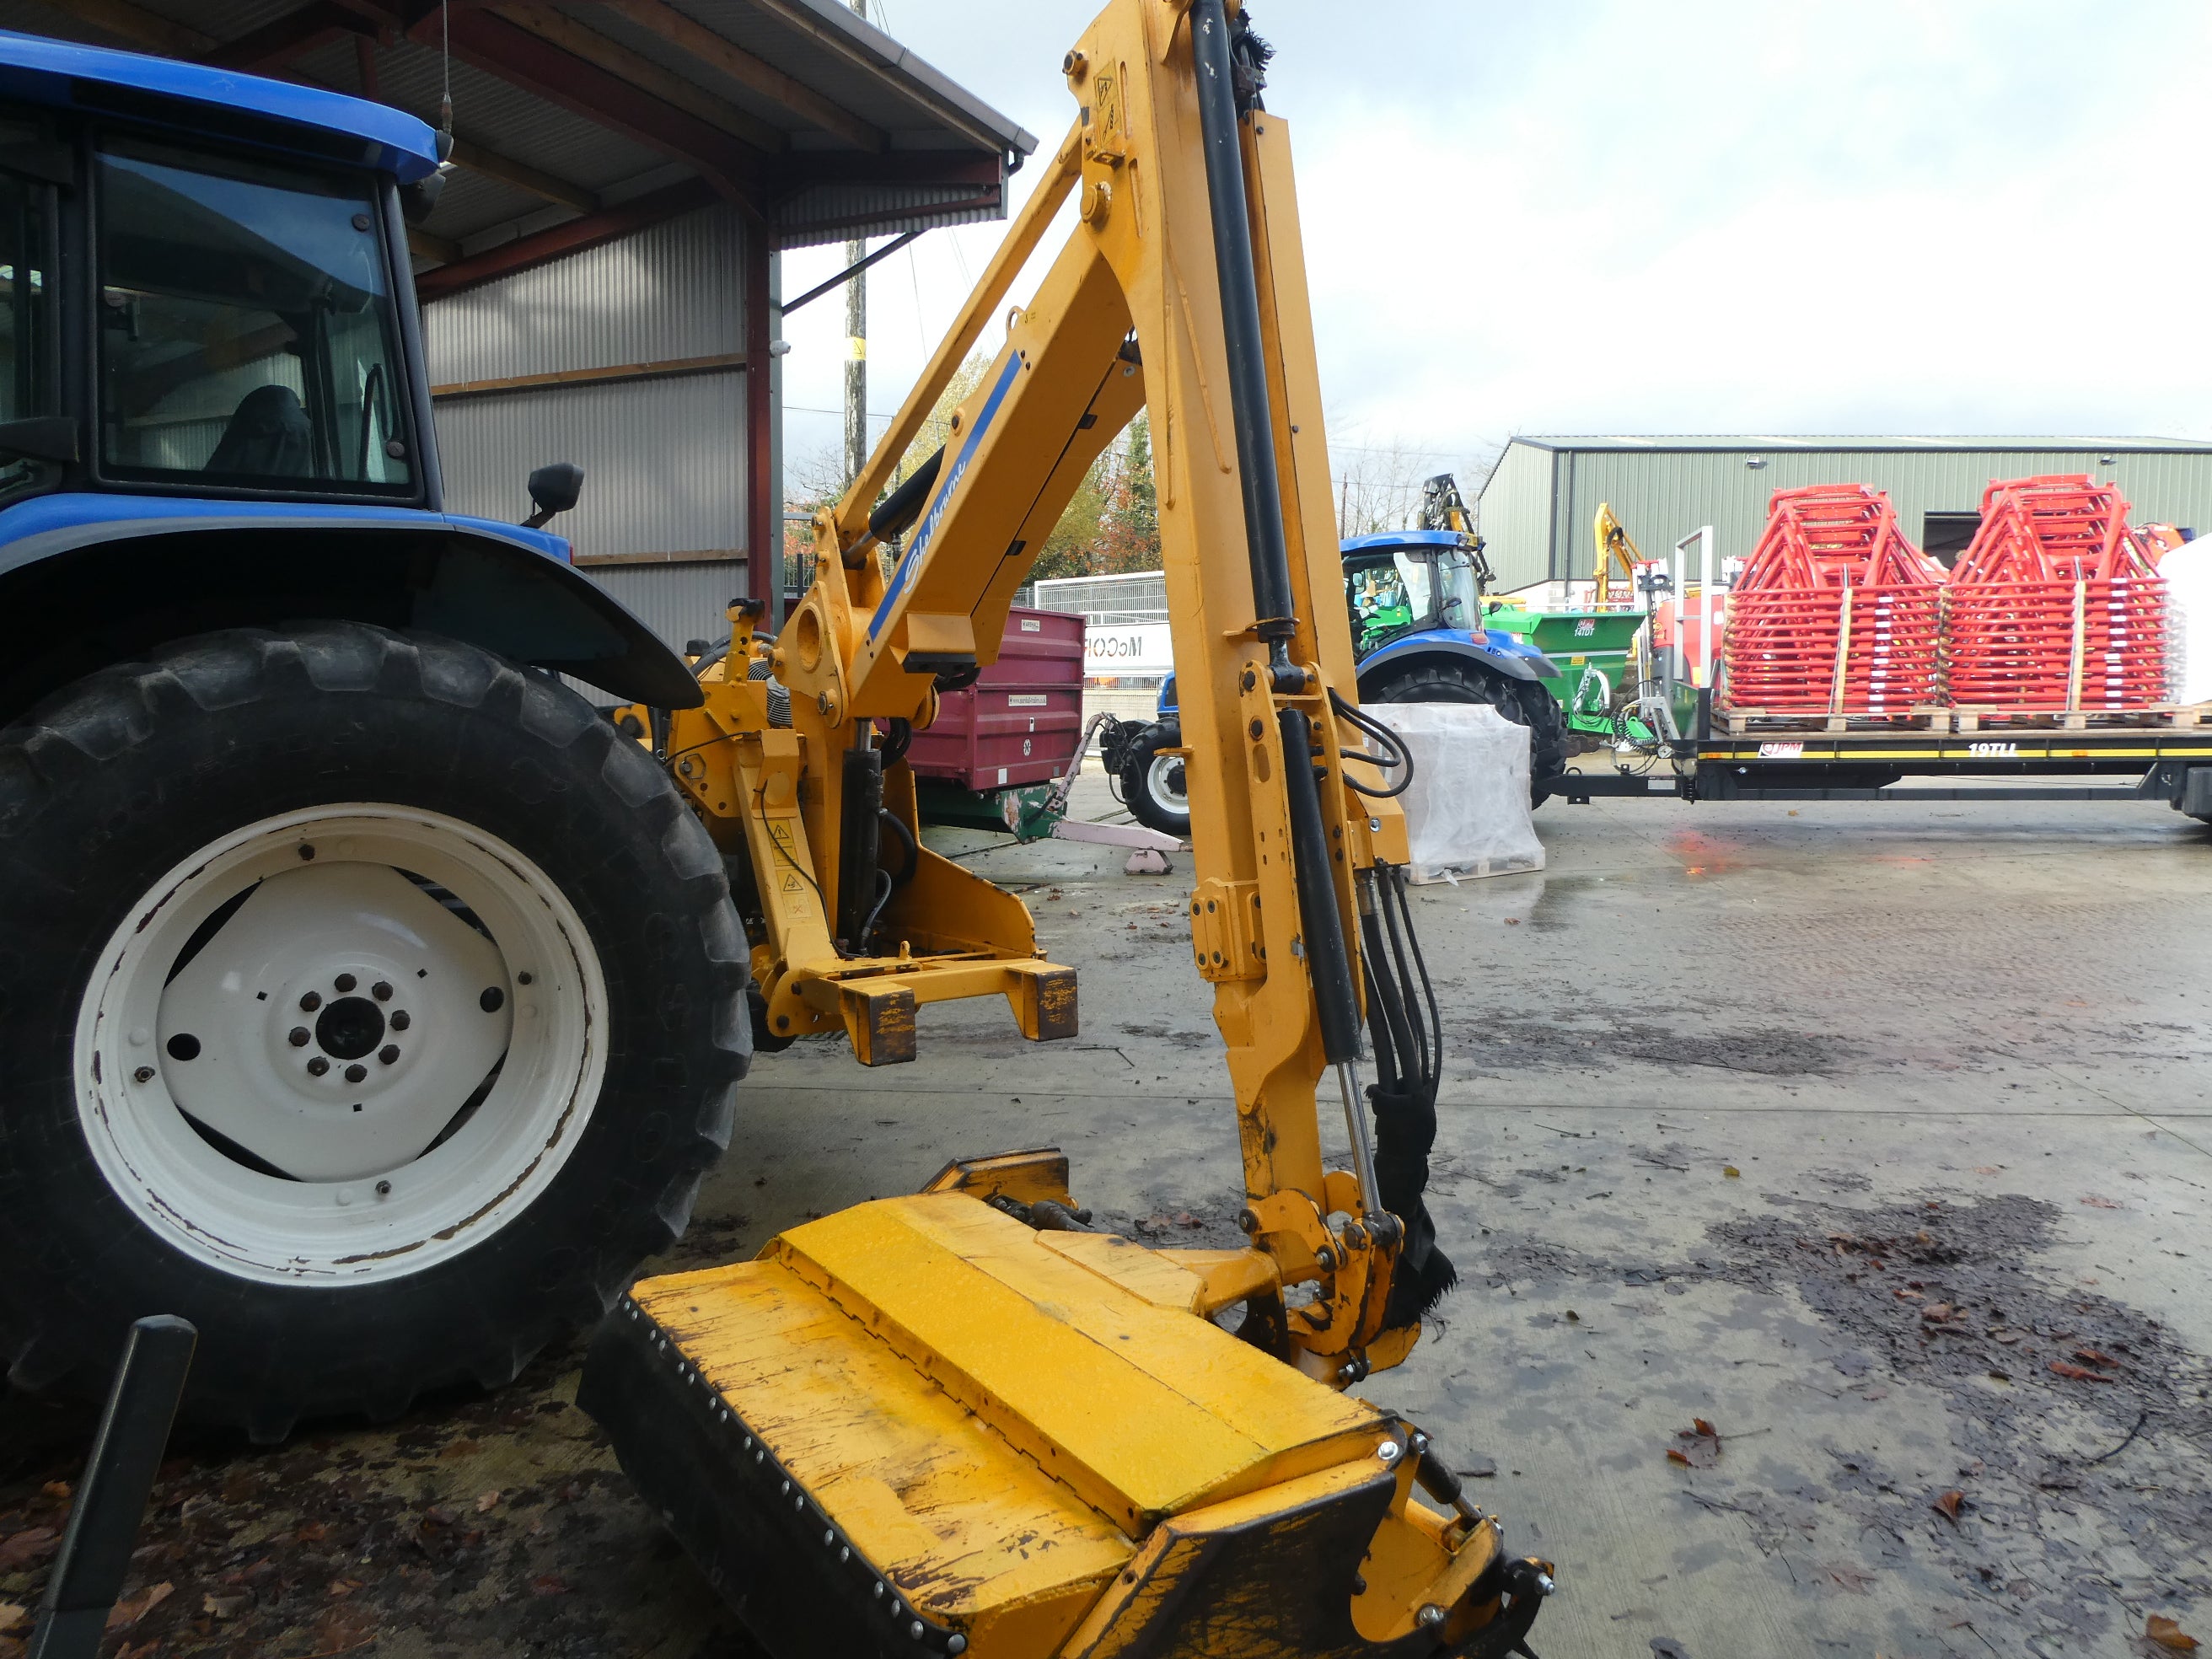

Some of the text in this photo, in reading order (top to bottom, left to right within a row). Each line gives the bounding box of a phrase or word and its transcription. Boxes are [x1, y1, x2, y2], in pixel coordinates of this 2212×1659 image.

[905, 461, 966, 594] Shelbourne
[1774, 743, 1802, 754] JPM
[1968, 743, 2018, 757] 19TLL
